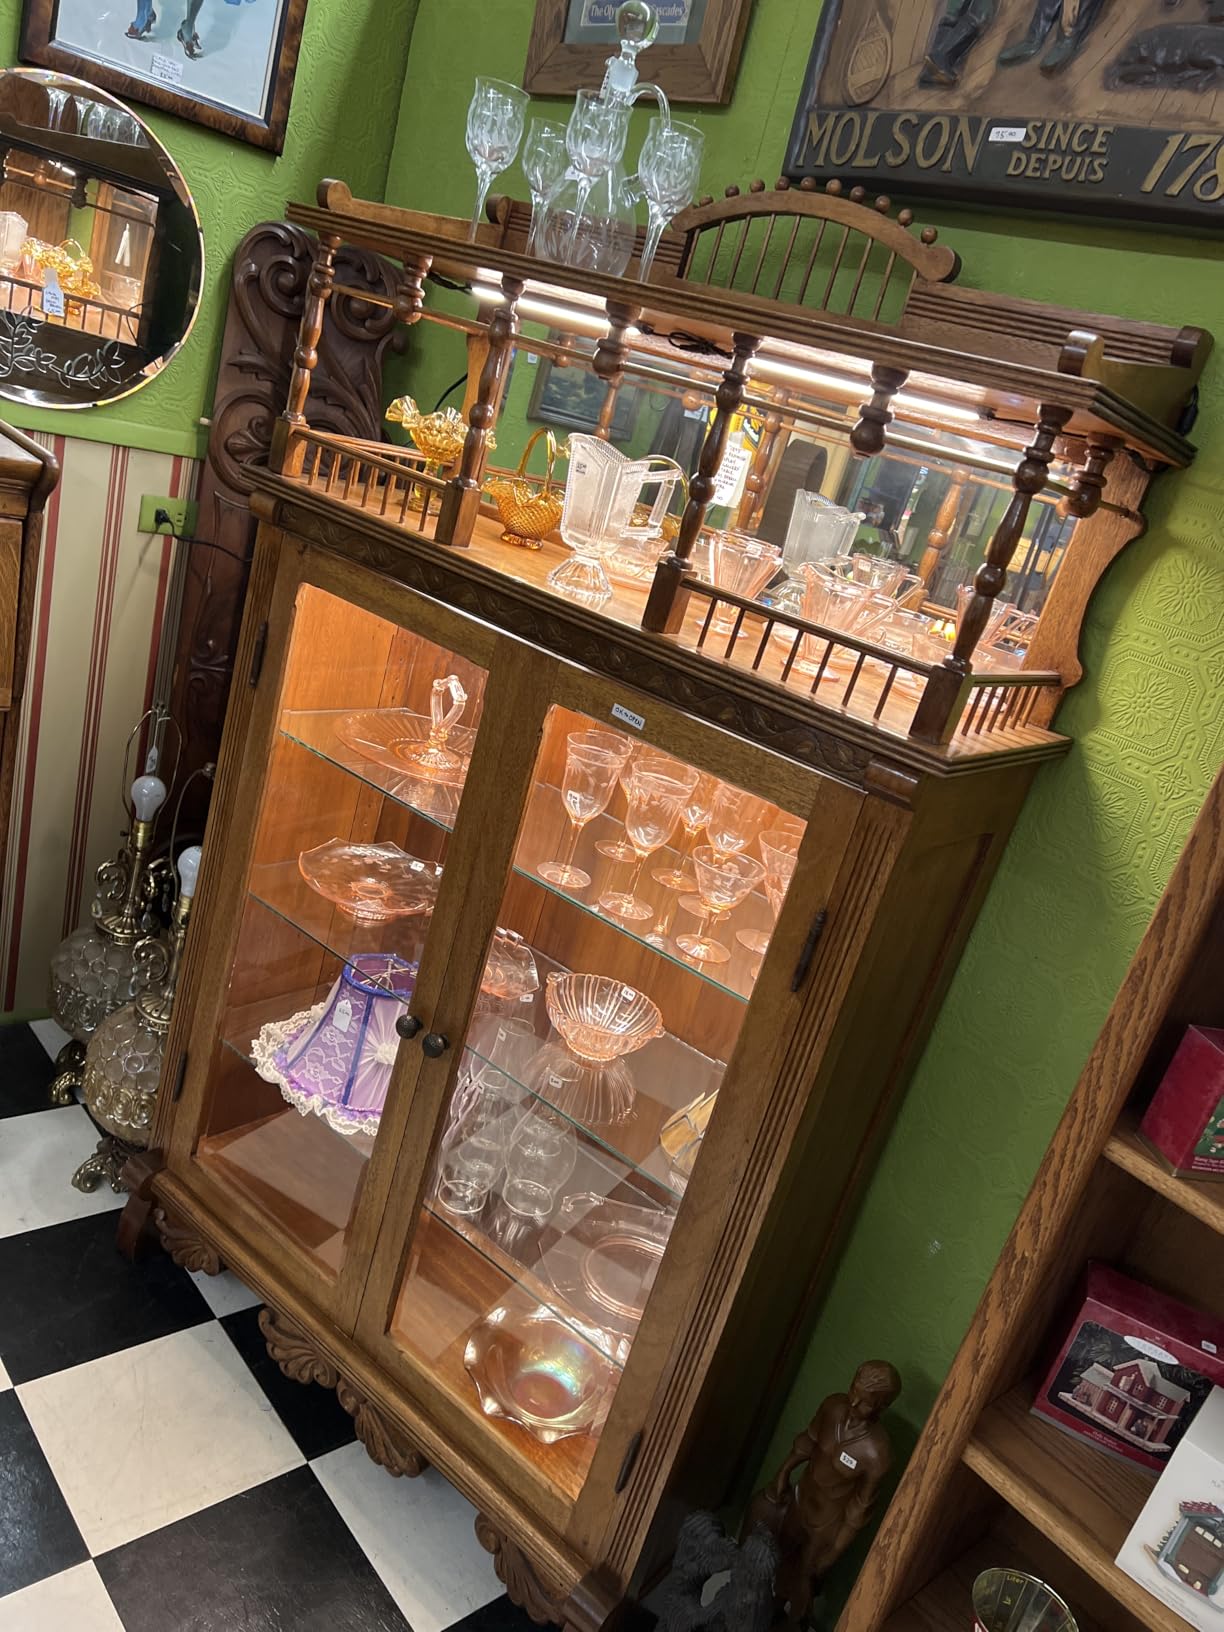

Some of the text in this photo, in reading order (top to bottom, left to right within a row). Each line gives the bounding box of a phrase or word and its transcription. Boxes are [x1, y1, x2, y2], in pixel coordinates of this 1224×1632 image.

[591, 4, 603, 17] The
[796, 111, 991, 174] MOLSON
[1021, 119, 1117, 155] SINCE
[1006, 151, 1108, 183] DEPUIS
